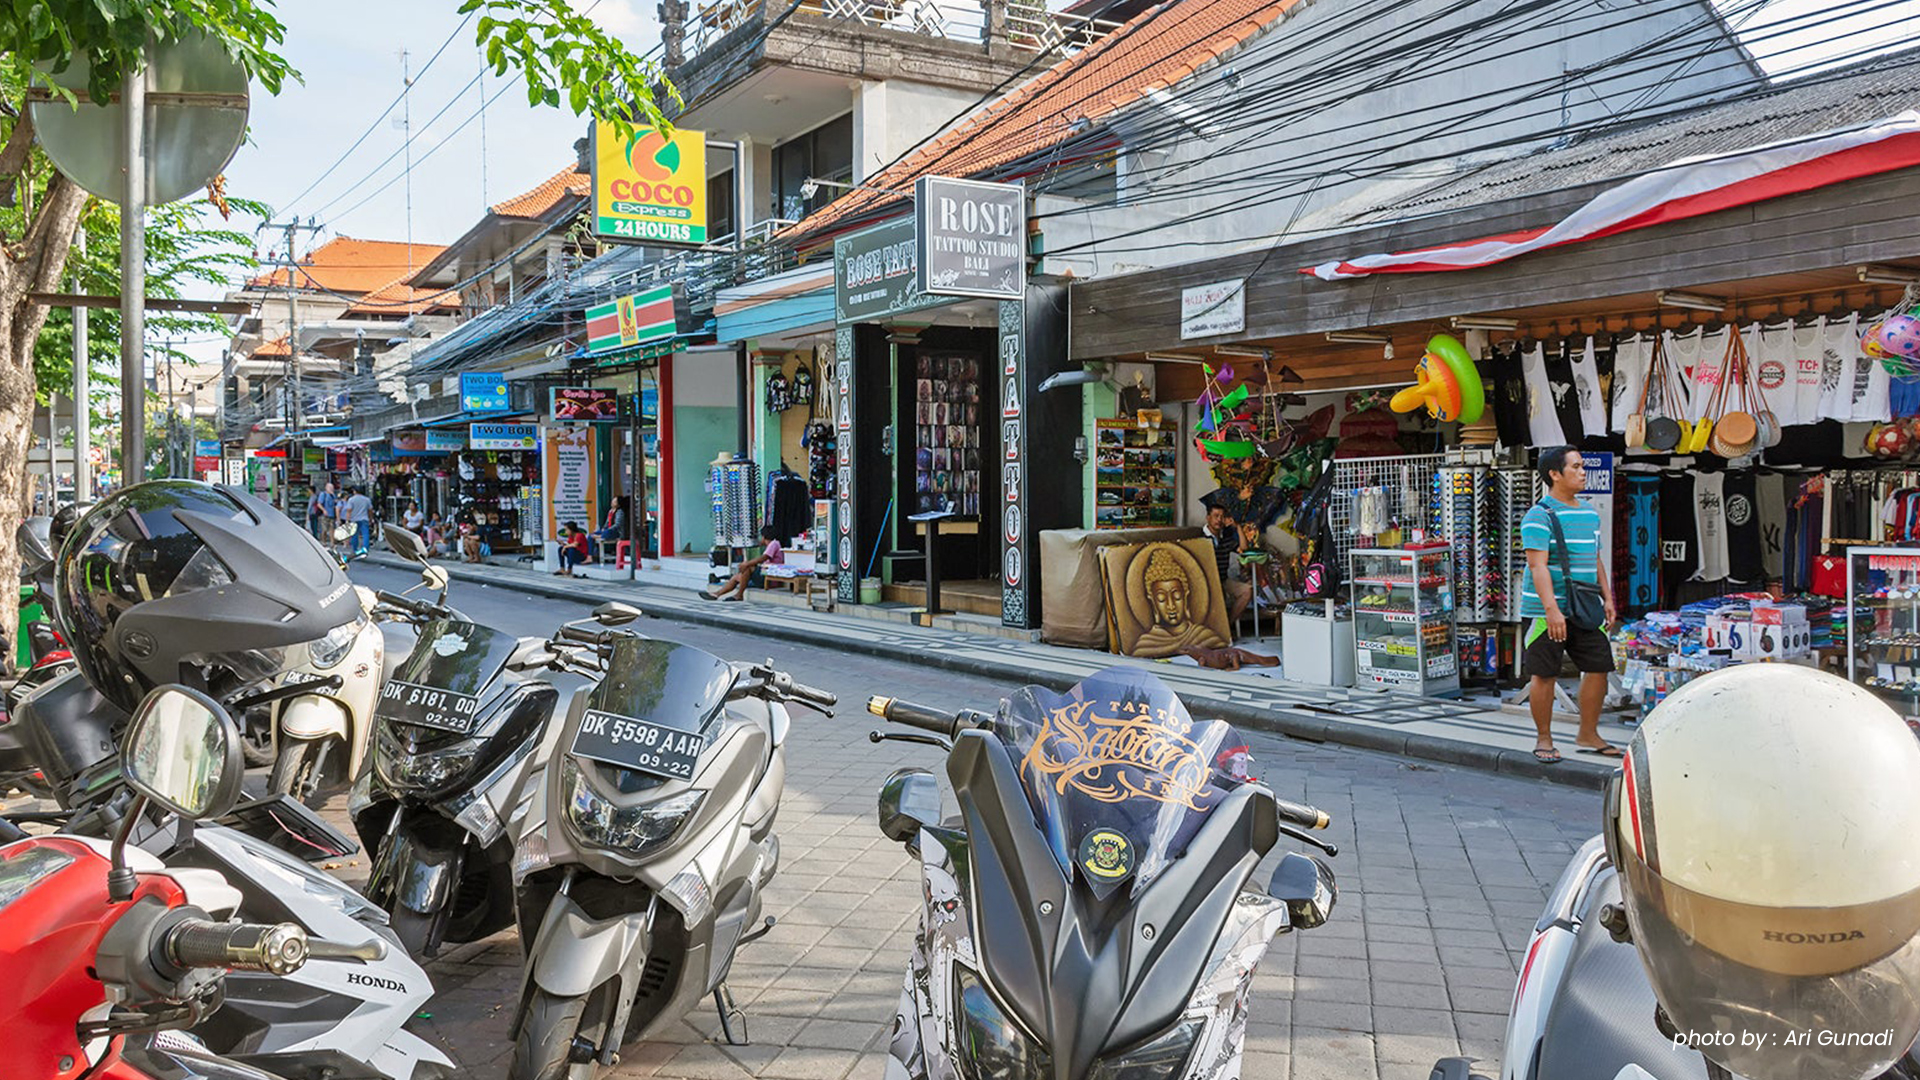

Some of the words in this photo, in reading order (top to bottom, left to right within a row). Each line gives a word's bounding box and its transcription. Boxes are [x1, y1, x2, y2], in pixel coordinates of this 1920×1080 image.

[610, 179, 694, 206] COCO
[617, 203, 687, 218] Express
[940, 196, 1013, 237] ROSE
[614, 220, 634, 236] 24
[635, 222, 690, 239] HOURS
[934, 236, 977, 254] TATTOO
[979, 240, 1018, 258] STUDIO
[846, 249, 882, 289] ROSE
[883, 239, 917, 279] TATT
[964, 256, 989, 270] BALI
[477, 426, 503, 435] TWO
[508, 427, 533, 435] BOB
[838, 360, 851, 569] TATTOO
[1002, 334, 1021, 586] TATTOO
[1585, 469, 1610, 491] HANGER
[318, 583, 350, 609] HONDA
[384, 683, 406, 700] DK
[410, 689, 447, 709] 6181
[1110, 701, 1191, 734] TATTOO
[582, 714, 609, 736] DK
[611, 720, 659, 746] 5598
[660, 732, 702, 757] AAH
[1763, 930, 1865, 944] HONDA
[347, 972, 407, 994] HONDA
